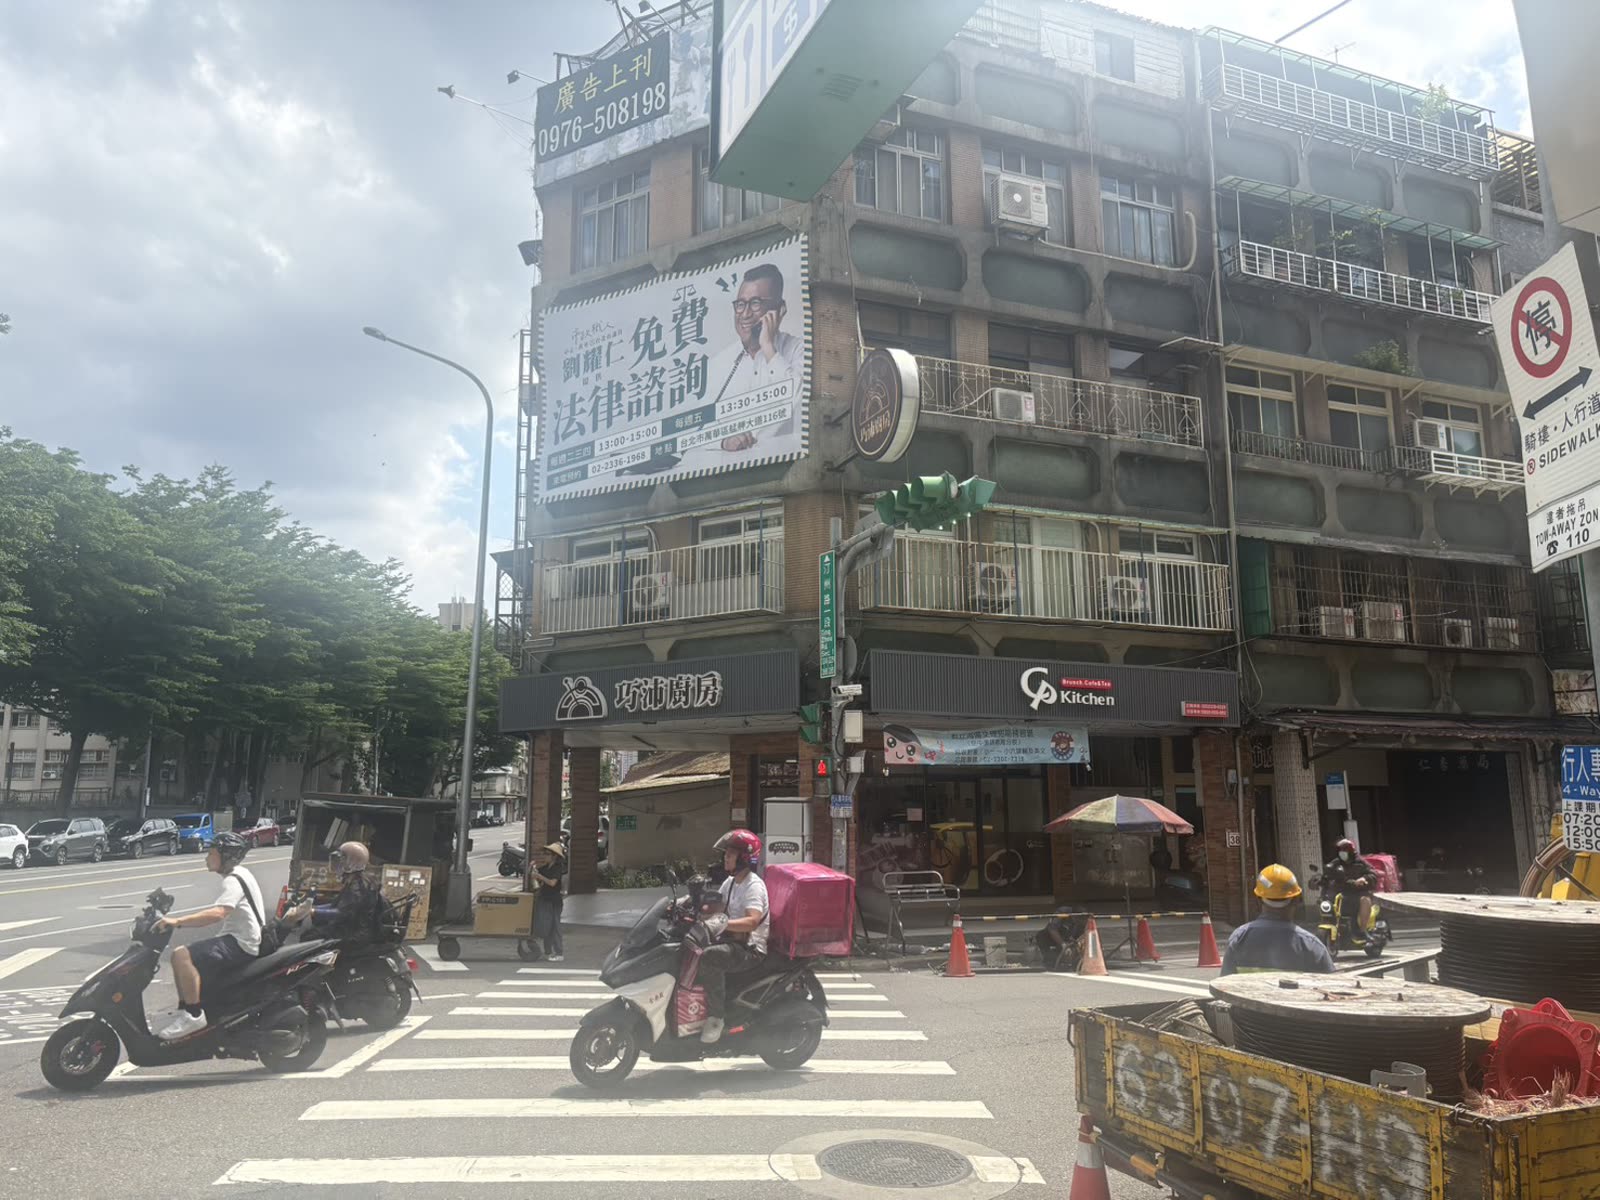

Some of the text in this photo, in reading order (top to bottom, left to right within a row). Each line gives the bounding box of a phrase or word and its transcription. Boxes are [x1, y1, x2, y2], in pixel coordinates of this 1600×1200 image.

[555, 48, 652, 114] 廣告上刊
[538, 82, 666, 156] 0976-508198
[628, 296, 709, 370] 免費
[1525, 300, 1557, 356] 停
[562, 339, 624, 383] 劉耀仁
[553, 352, 709, 446] 法律諮詢
[720, 385, 787, 414] 13:30-15:00
[599, 426, 658, 452] 13:00-15:00
[592, 450, 646, 474] 02-2336-1968
[1535, 516, 1576, 548] TOW-AWAY
[1566, 528, 1590, 549] 110
[614, 671, 723, 713] 巧沛廚房
[1060, 690, 1115, 706] Kitchen
